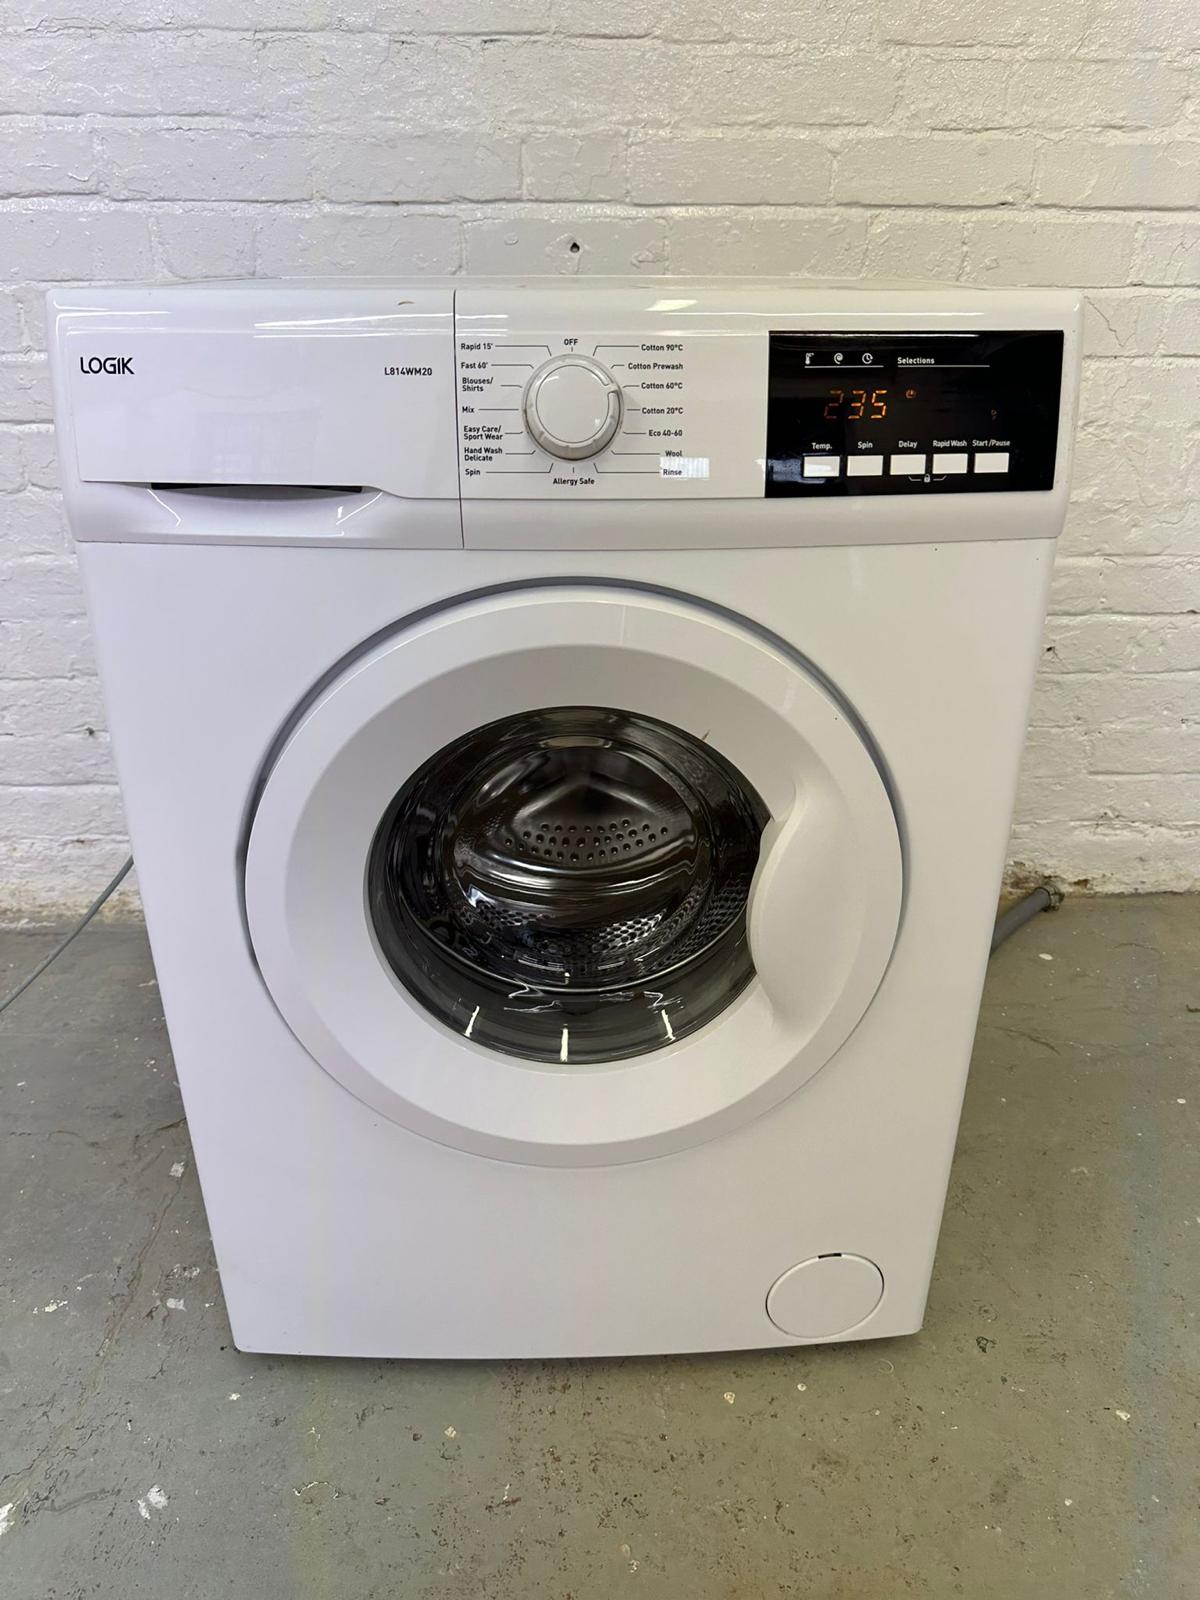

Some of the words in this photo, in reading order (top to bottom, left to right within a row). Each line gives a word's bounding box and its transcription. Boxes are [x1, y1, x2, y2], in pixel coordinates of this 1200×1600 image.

[563, 338, 579, 346] OFF
[460, 342, 481, 351] Rapid
[641, 343, 665, 351] Cotton
[897, 356, 935, 364] Selections
[80, 356, 135, 375] LOGIK
[460, 361, 476, 369] Fast
[627, 362, 652, 370] Cotton
[652, 362, 684, 370] Prewash
[384, 367, 433, 376] L814WM20
[462, 376, 494, 385] Blouses/
[462, 384, 484, 392] Shirts
[462, 406, 475, 414] Mix
[463, 425, 481, 434] Easy
[481, 424, 502, 433] Care/
[648, 429, 661, 437] Eco
[662, 429, 683, 437] 40-60
[463, 433, 483, 441] Sport
[811, 442, 833, 451] Temp.
[857, 441, 873, 449] Spin
[898, 440, 918, 449] Delay
[932, 440, 950, 448] Rapid
[464, 446, 482, 454] Hand
[483, 446, 503, 454] Wash
[464, 454, 493, 462] Delicate
[465, 468, 481, 476] Spin
[662, 468, 683, 476] Rinse
[552, 477, 578, 486] Allergy
[579, 477, 595, 485] Safe
